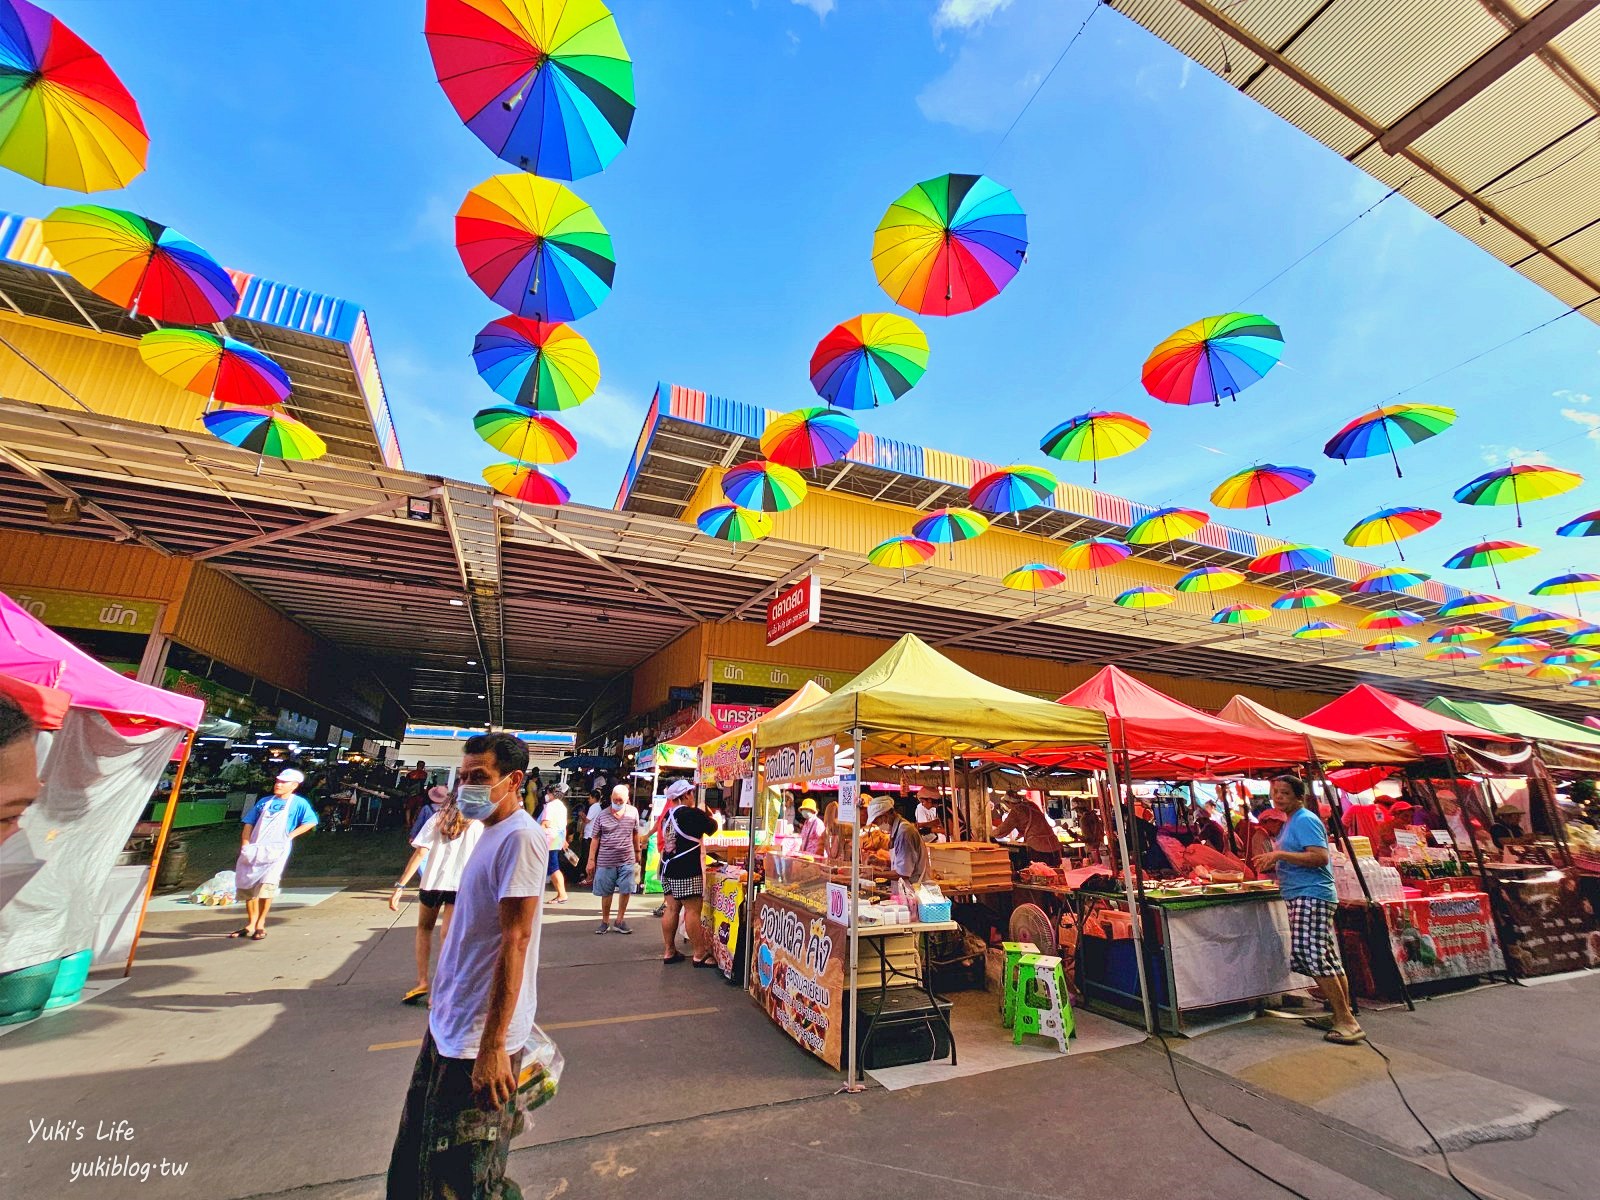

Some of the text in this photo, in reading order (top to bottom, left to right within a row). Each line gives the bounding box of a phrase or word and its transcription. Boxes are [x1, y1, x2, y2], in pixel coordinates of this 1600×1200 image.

[98, 603, 138, 626] ผัก
[772, 588, 804, 621] ตลาดสด
[724, 664, 744, 681] ผัก
[770, 668, 789, 685] ผัก
